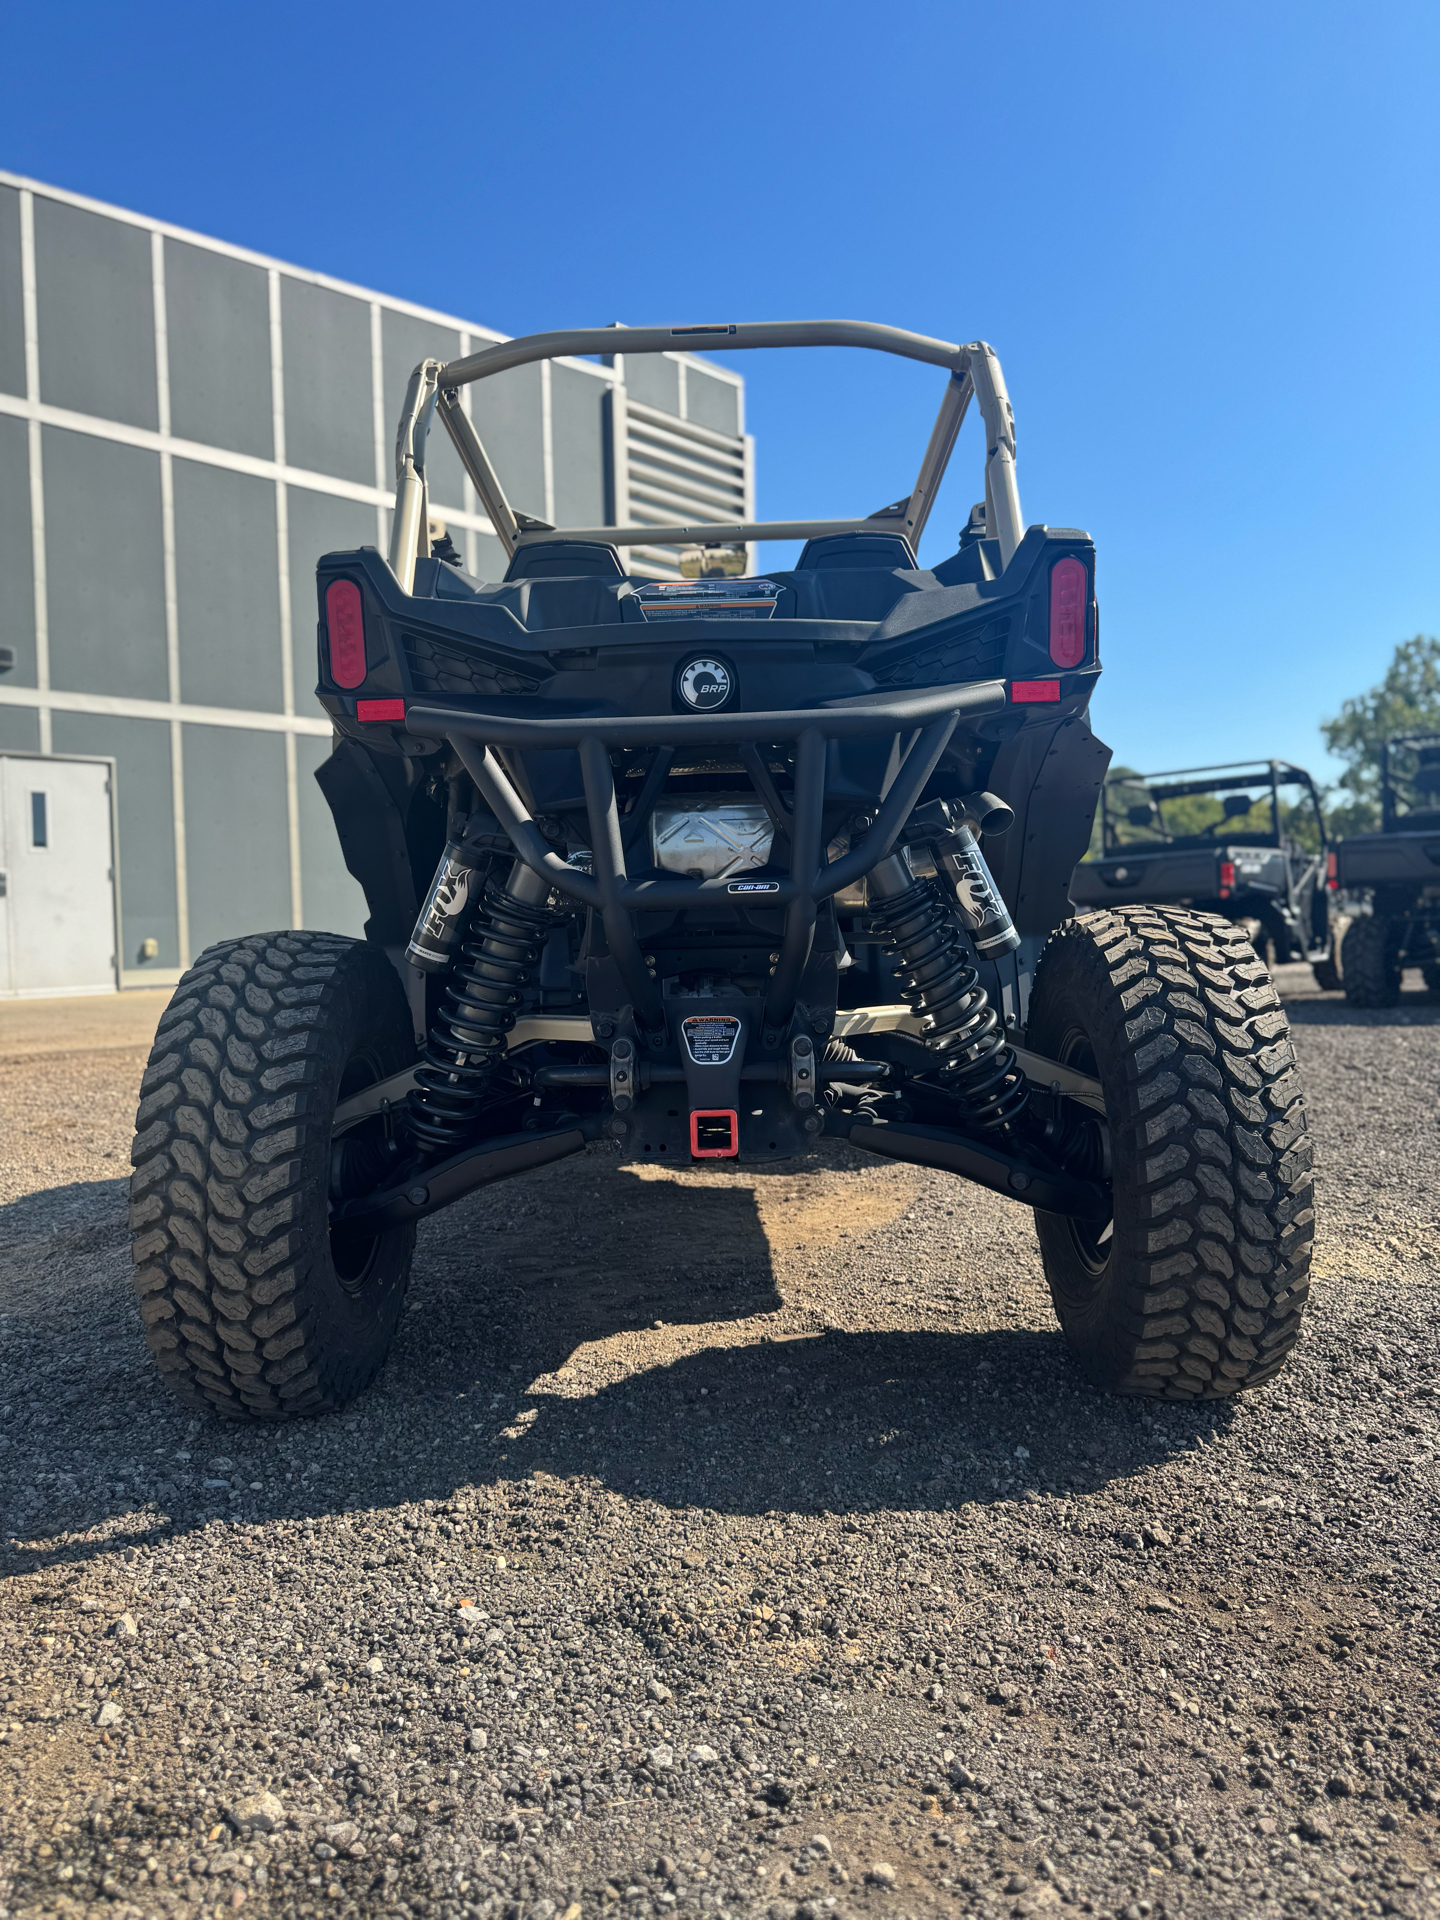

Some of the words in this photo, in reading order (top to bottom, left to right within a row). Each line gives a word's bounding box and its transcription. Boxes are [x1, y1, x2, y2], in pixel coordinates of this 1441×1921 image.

[700, 685, 727, 693] BRP
[423, 860, 471, 939] FOX
[952, 852, 1002, 926] FOX
